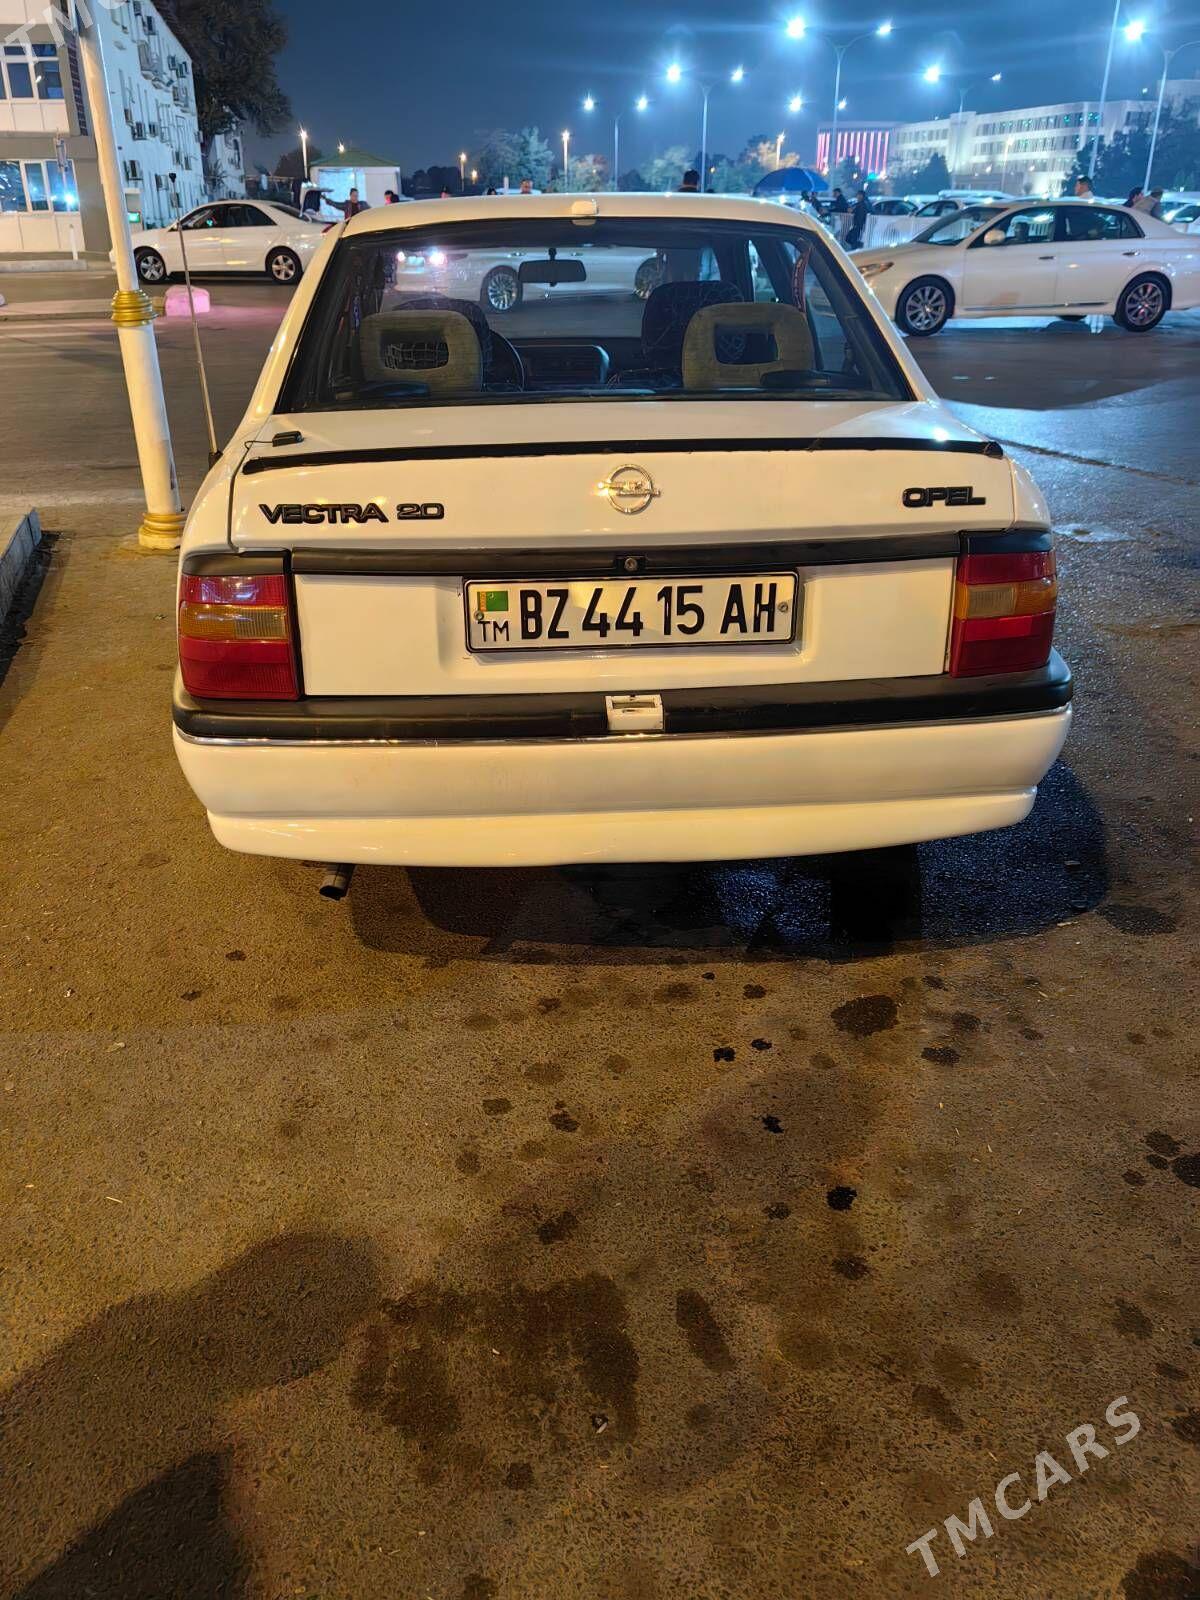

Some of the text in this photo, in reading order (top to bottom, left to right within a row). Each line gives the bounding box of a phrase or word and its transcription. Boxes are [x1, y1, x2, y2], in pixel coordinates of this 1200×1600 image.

[902, 486, 986, 508] OPEL
[259, 503, 389, 525] VECTRA
[520, 583, 778, 640] BZ 44 15 AH
[478, 620, 510, 642] TM
